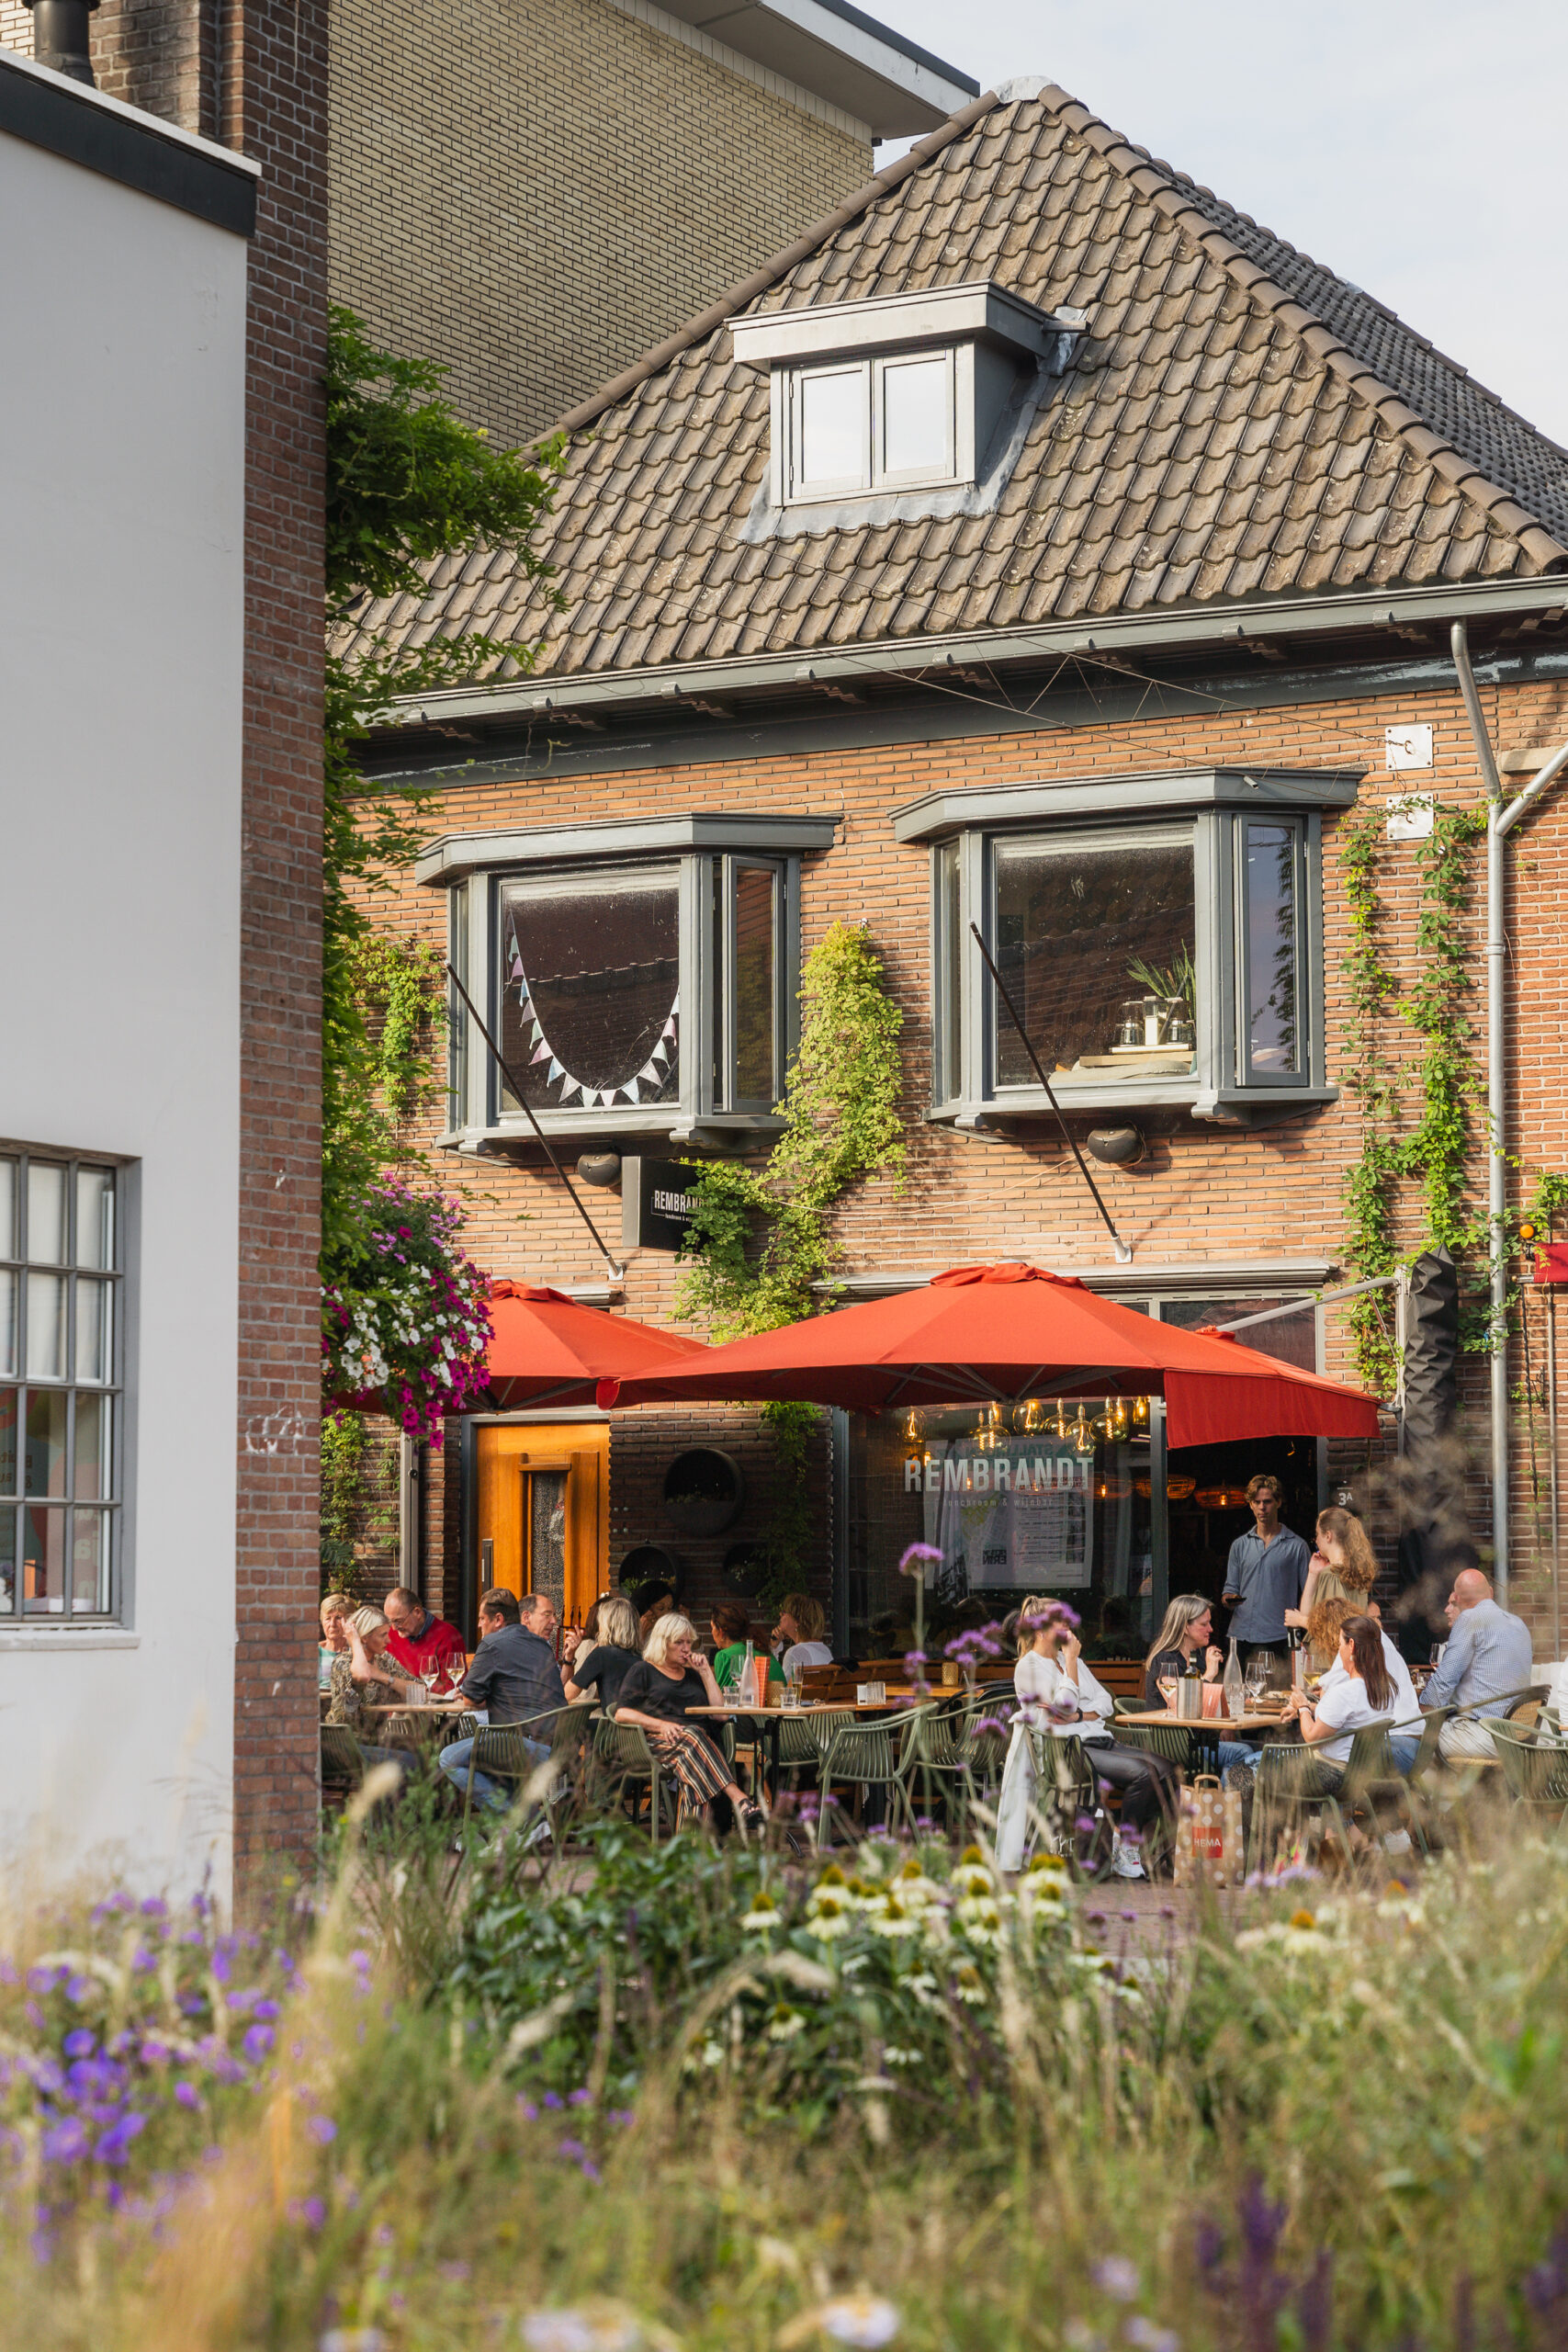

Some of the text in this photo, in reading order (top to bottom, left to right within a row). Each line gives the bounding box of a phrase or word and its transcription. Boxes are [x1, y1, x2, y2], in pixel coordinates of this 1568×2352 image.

[654, 1190, 705, 1213] REMBRAN
[905, 1457, 1093, 1492] REMBRANDT
[1002, 1497, 1008, 1506] &
[1338, 1492, 1353, 1506] 3A
[1194, 1838, 1222, 1848] HEMA
